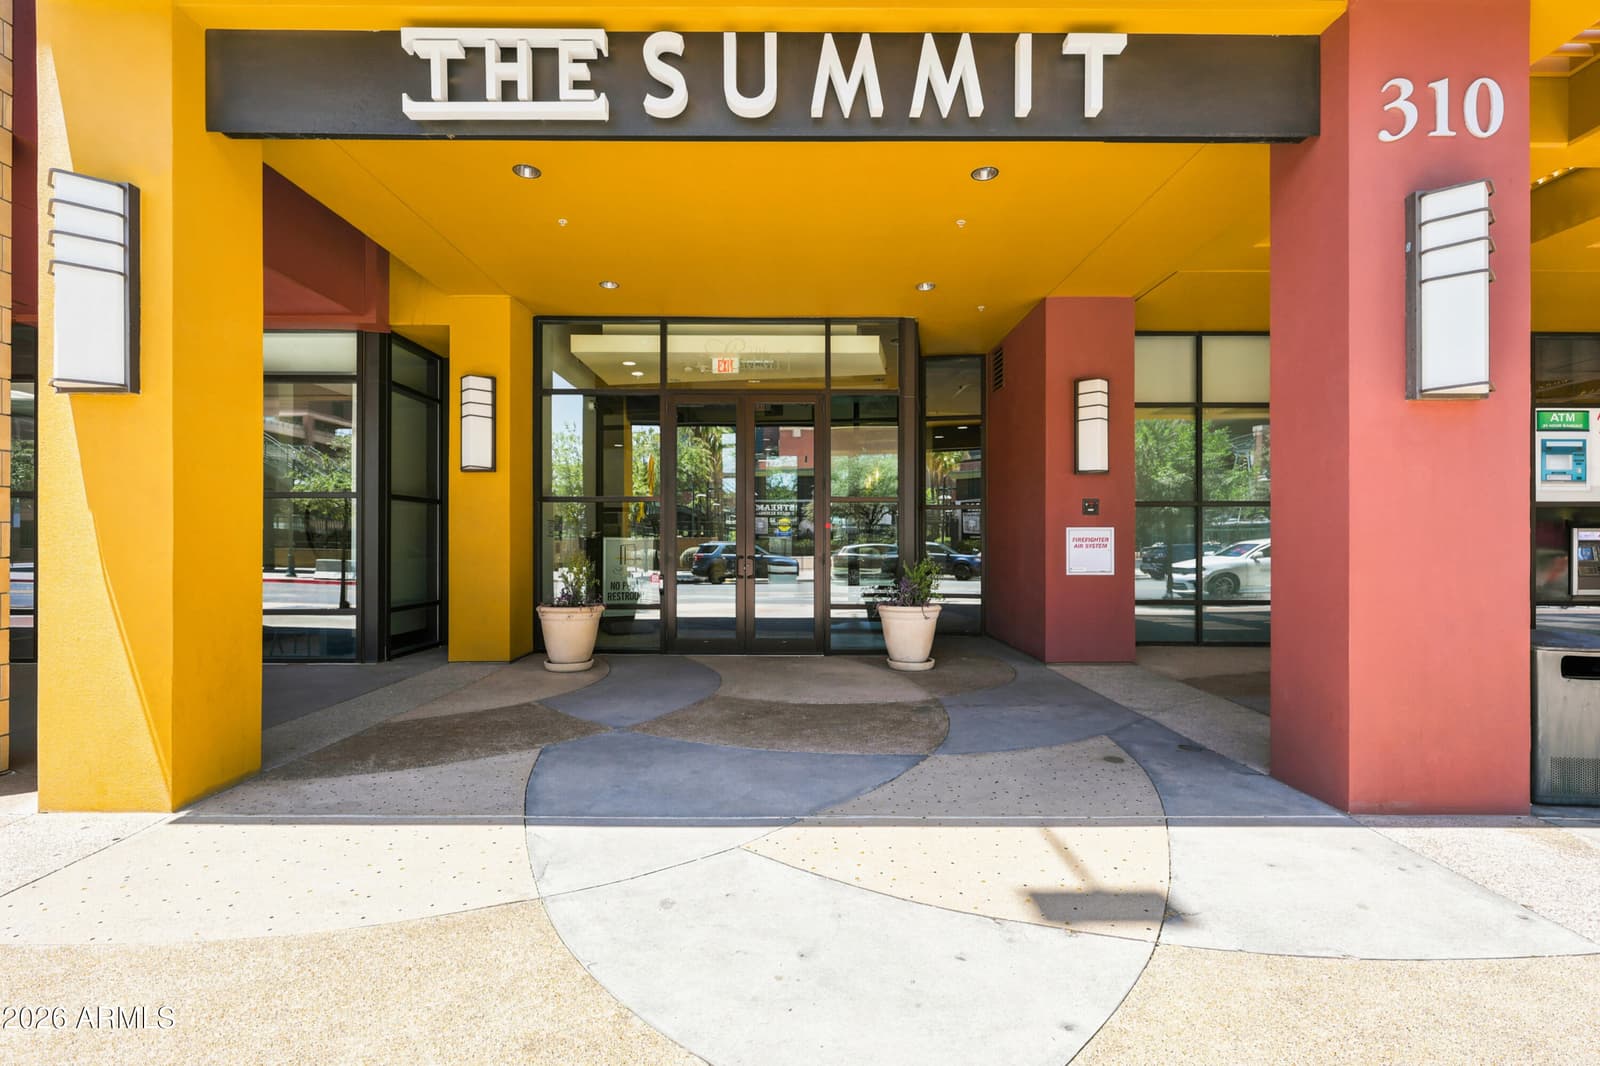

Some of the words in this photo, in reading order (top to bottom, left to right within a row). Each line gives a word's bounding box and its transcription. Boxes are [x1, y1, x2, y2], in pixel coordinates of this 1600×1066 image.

[411, 38, 600, 102] THE
[642, 31, 1128, 119] SUMMIT
[1377, 77, 1505, 143] 310
[717, 359, 734, 372] EXIT
[1550, 412, 1575, 422] ATM
[610, 581, 620, 591] NO
